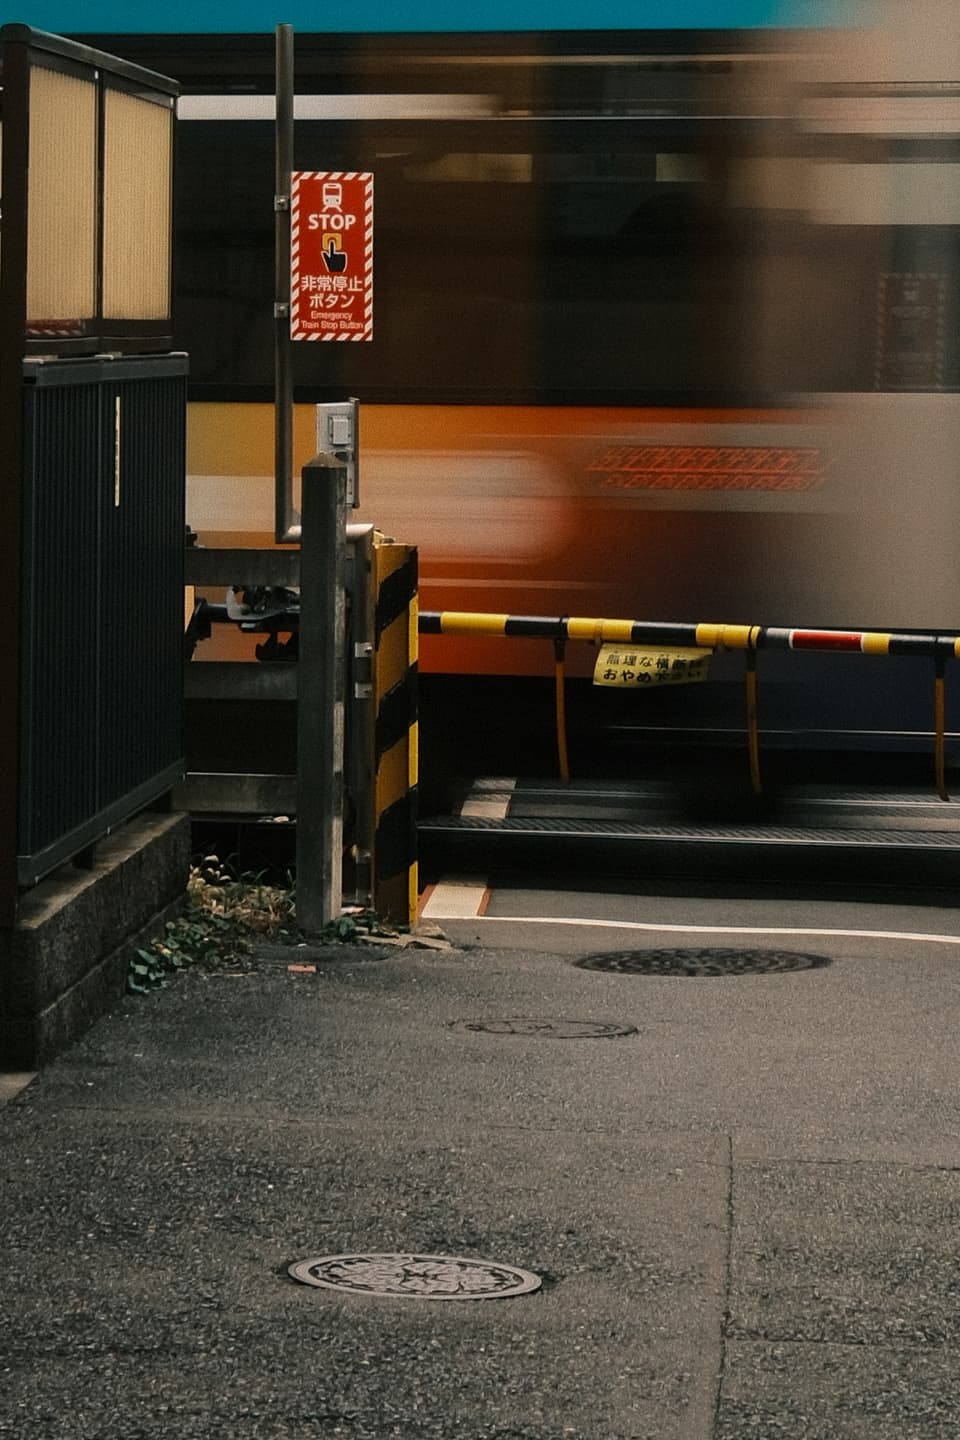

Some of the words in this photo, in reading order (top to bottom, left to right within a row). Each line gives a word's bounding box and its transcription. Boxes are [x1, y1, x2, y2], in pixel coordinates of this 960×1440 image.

[308, 214, 356, 230] STOP
[301, 275, 363, 292] 非常停止
[309, 293, 355, 309] ボタン
[310, 310, 353, 321] Emergency
[301, 320, 319, 329] Train
[321, 320, 338, 331] Stop
[339, 320, 363, 329] Button
